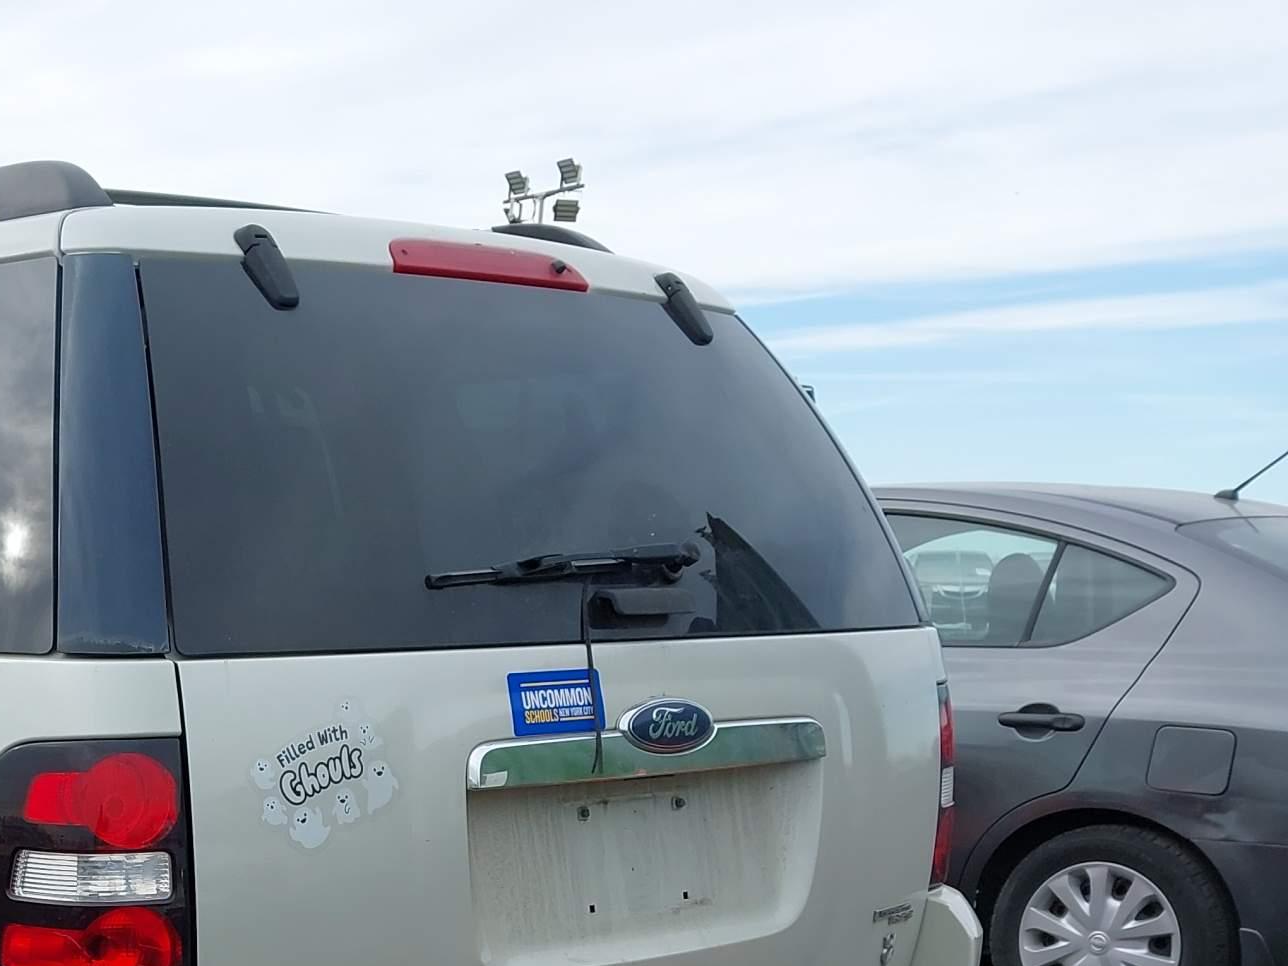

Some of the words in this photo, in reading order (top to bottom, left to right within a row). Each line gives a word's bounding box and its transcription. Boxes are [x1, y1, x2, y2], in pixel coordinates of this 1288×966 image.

[520, 687, 593, 710] UNCOMMON
[524, 708, 560, 724] SCHOOLS
[558, 707, 570, 717] NEW
[570, 706, 583, 717] YORK
[583, 706, 594, 716] CITY
[649, 706, 698, 740] Ford
[276, 734, 316, 768] Filled
[317, 724, 349, 746] With
[279, 744, 364, 806] Ghouls
